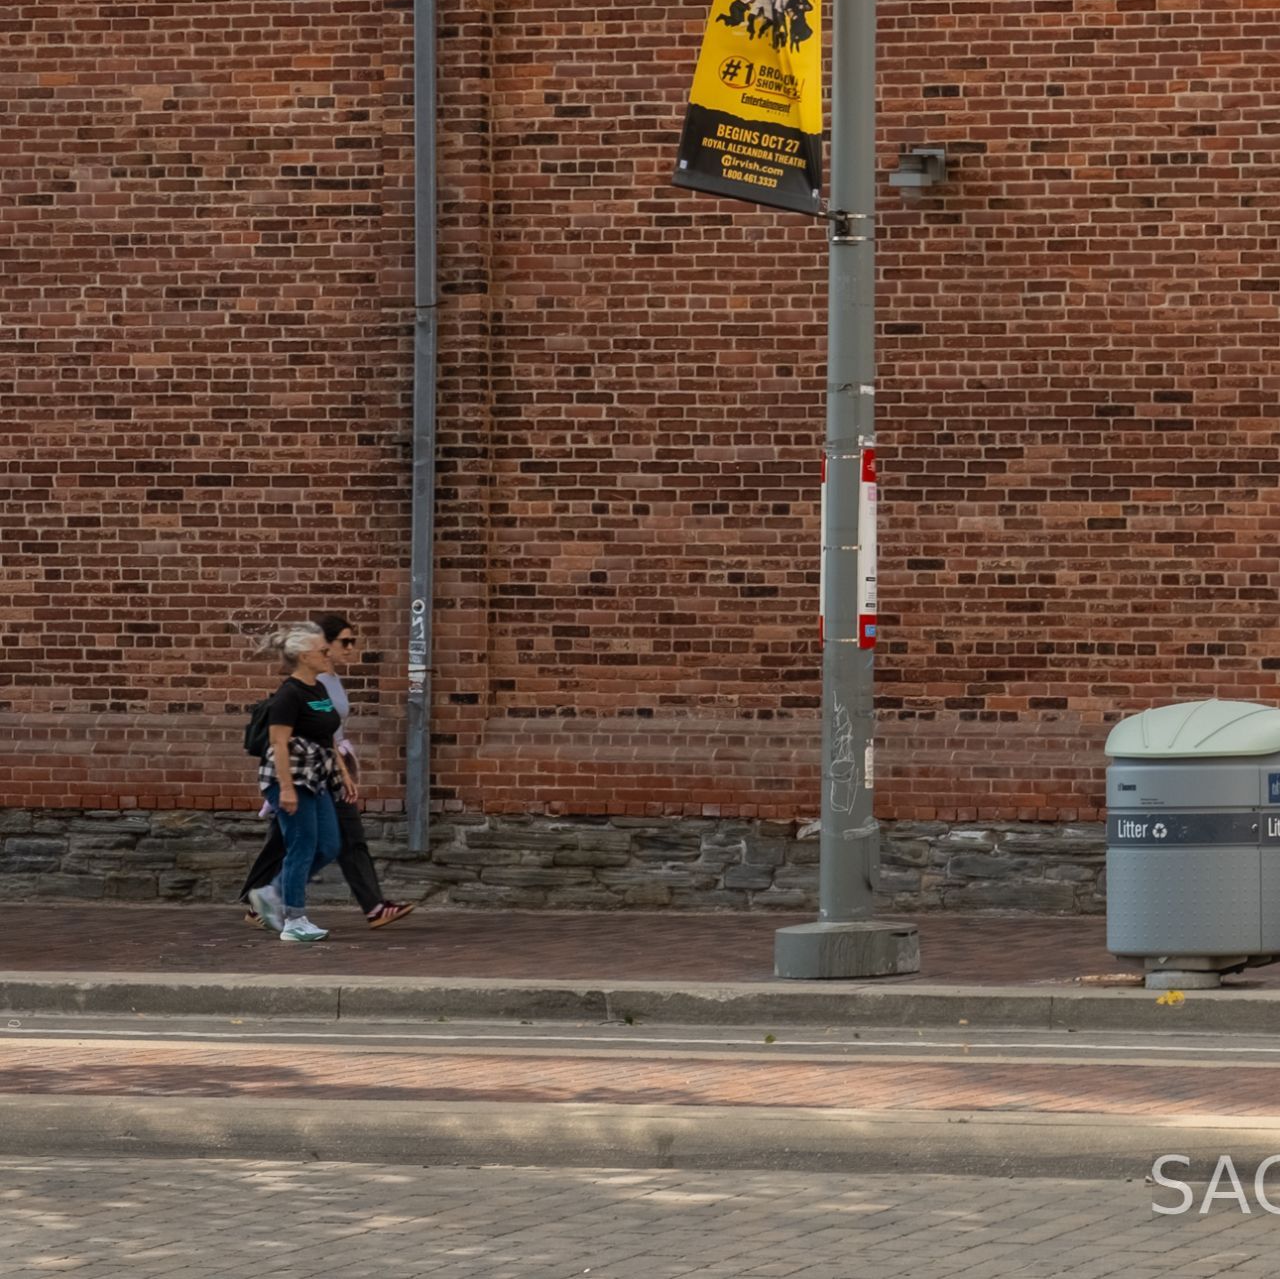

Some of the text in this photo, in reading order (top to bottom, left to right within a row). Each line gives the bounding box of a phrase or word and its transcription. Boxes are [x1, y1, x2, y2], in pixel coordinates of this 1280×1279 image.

[722, 58, 754, 85] #1
[741, 93, 791, 113] Entertainment
[702, 137, 727, 151] ROYAL
[727, 143, 773, 161] ALEXANDRA
[717, 124, 800, 154] BEGINS OCT 27
[1118, 819, 1149, 838] Litter
